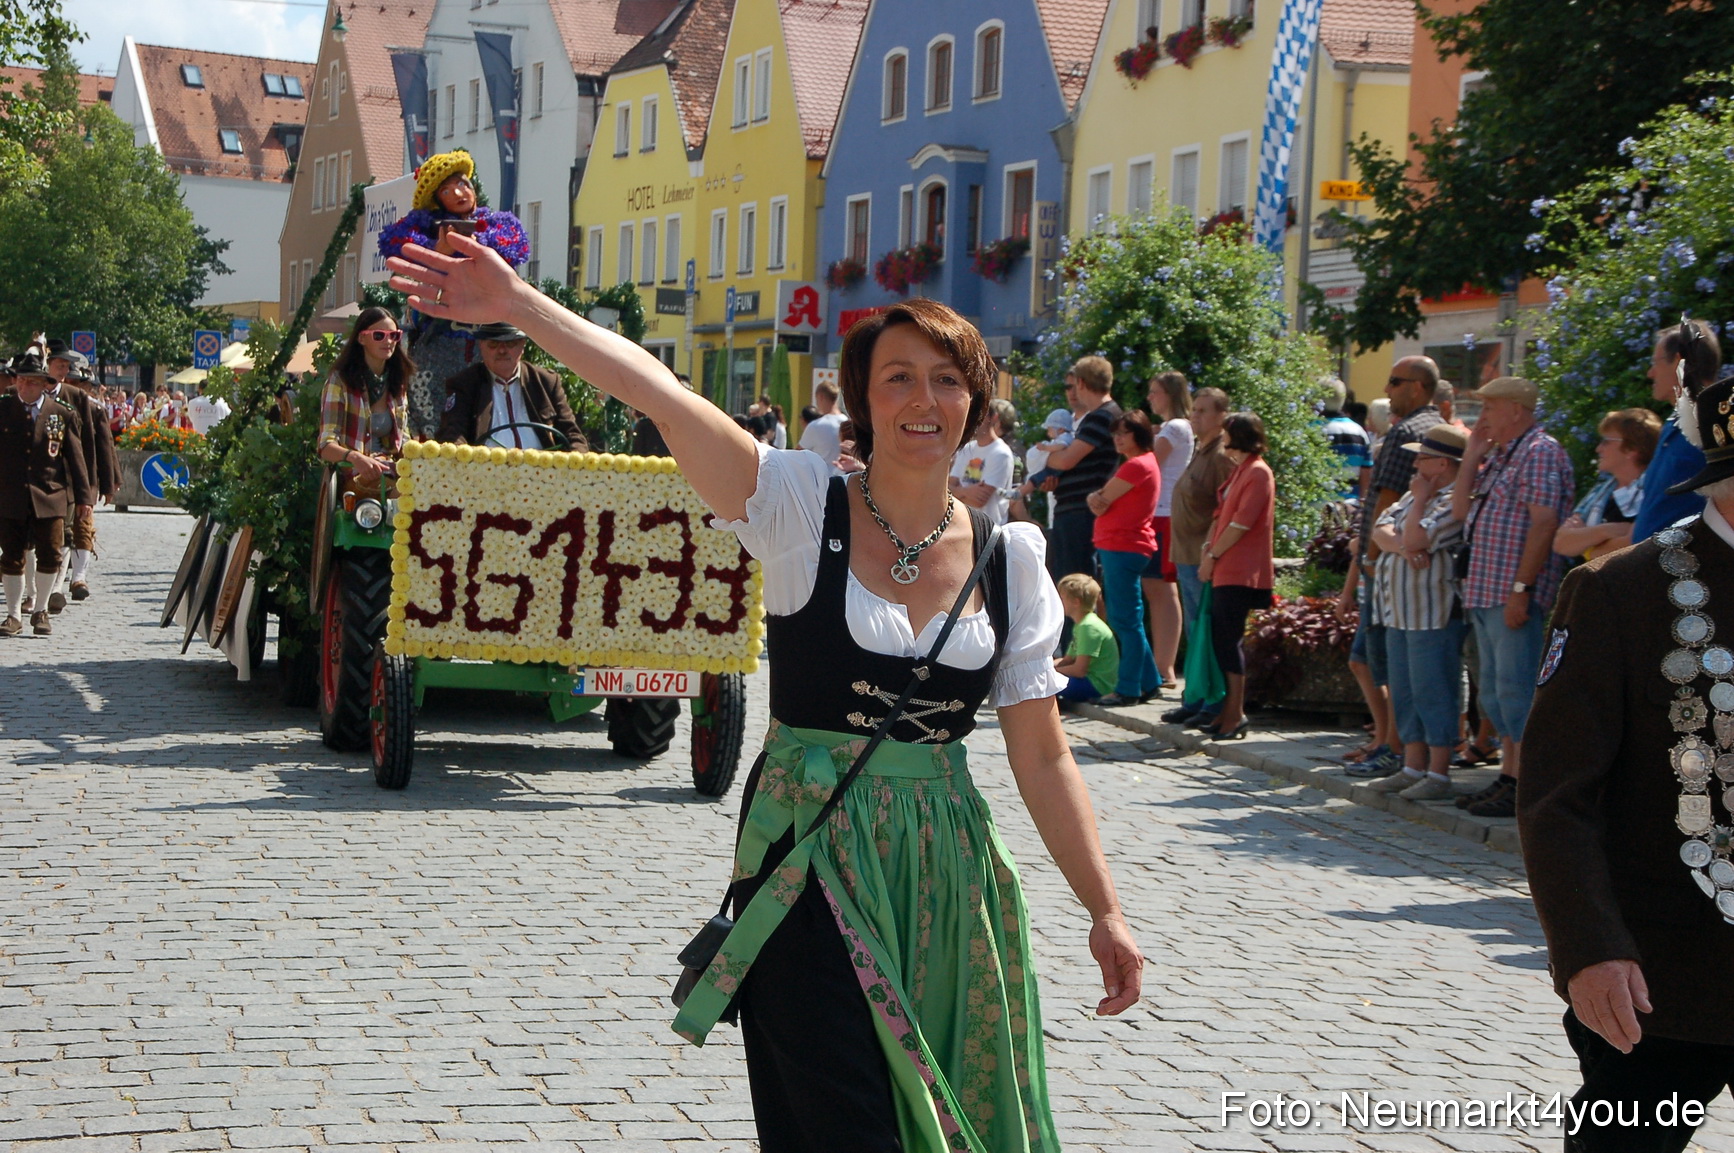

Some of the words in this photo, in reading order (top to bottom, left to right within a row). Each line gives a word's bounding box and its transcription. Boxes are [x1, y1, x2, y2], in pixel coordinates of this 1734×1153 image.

[627, 185, 655, 212] HOTEL
[662, 181, 695, 205] Lehmeier
[658, 303, 686, 313] TAIFU
[196, 357, 219, 368] TAXI
[594, 671, 623, 692] NM
[636, 672, 688, 693] 0670
